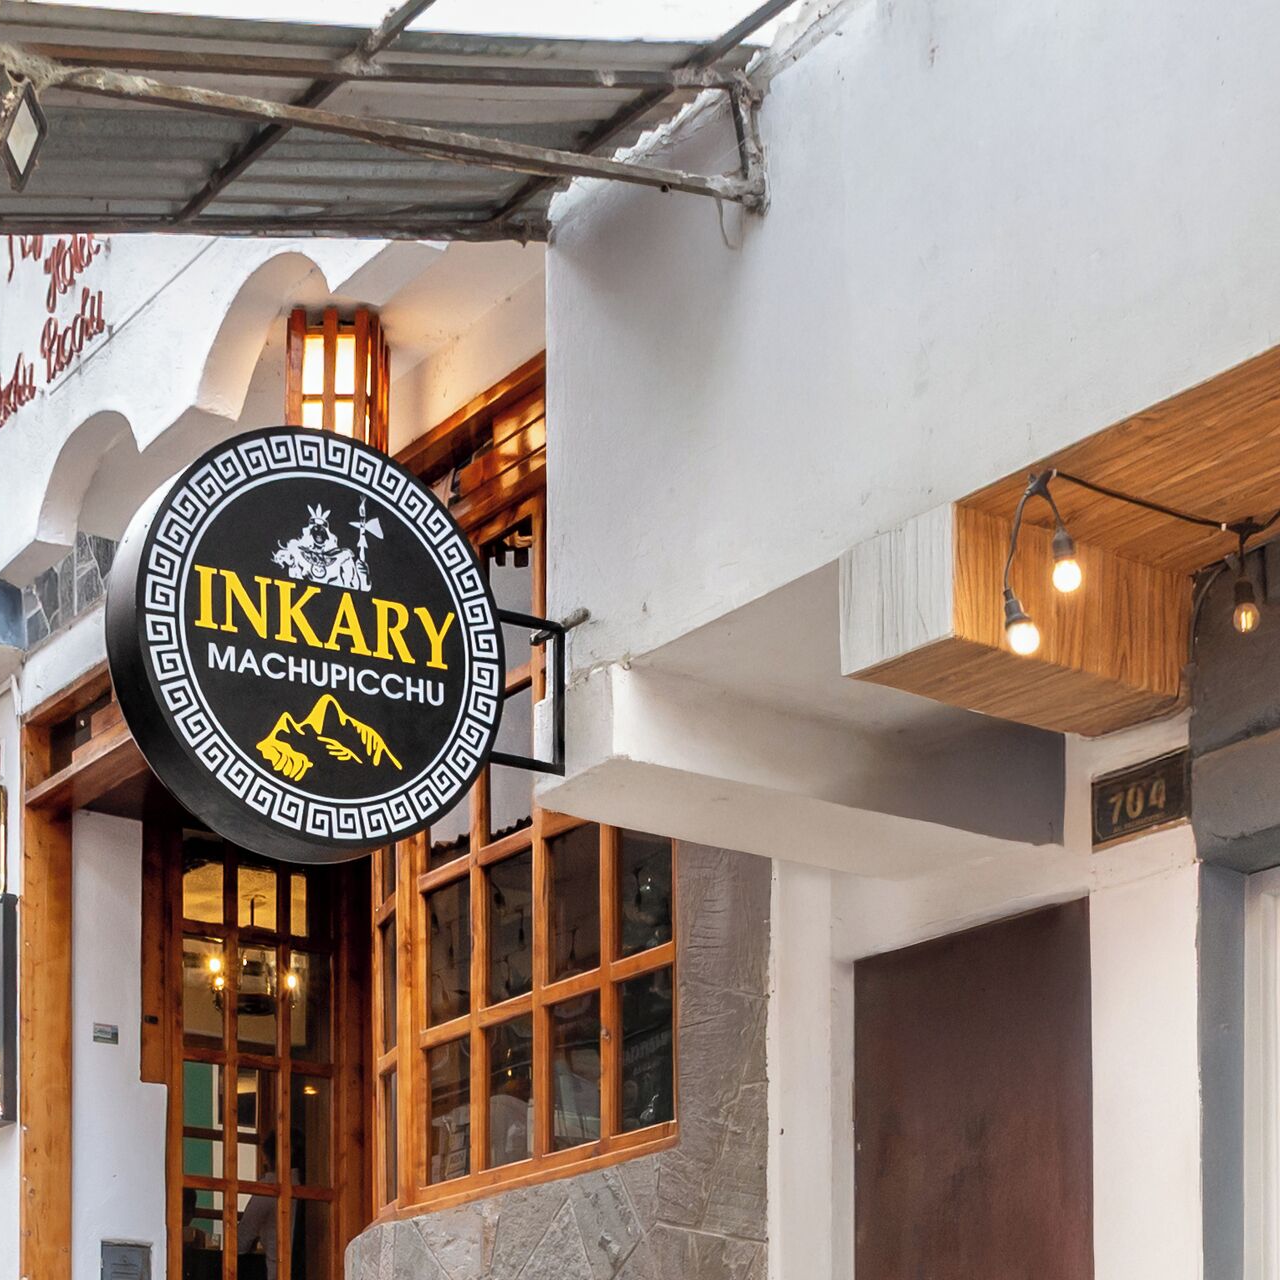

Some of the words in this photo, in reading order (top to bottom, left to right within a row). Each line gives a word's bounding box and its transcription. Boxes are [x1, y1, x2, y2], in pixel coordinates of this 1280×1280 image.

[194, 564, 455, 671] INKARY
[207, 642, 445, 707] MACHUPICCHU
[1108, 776, 1167, 825] 704
